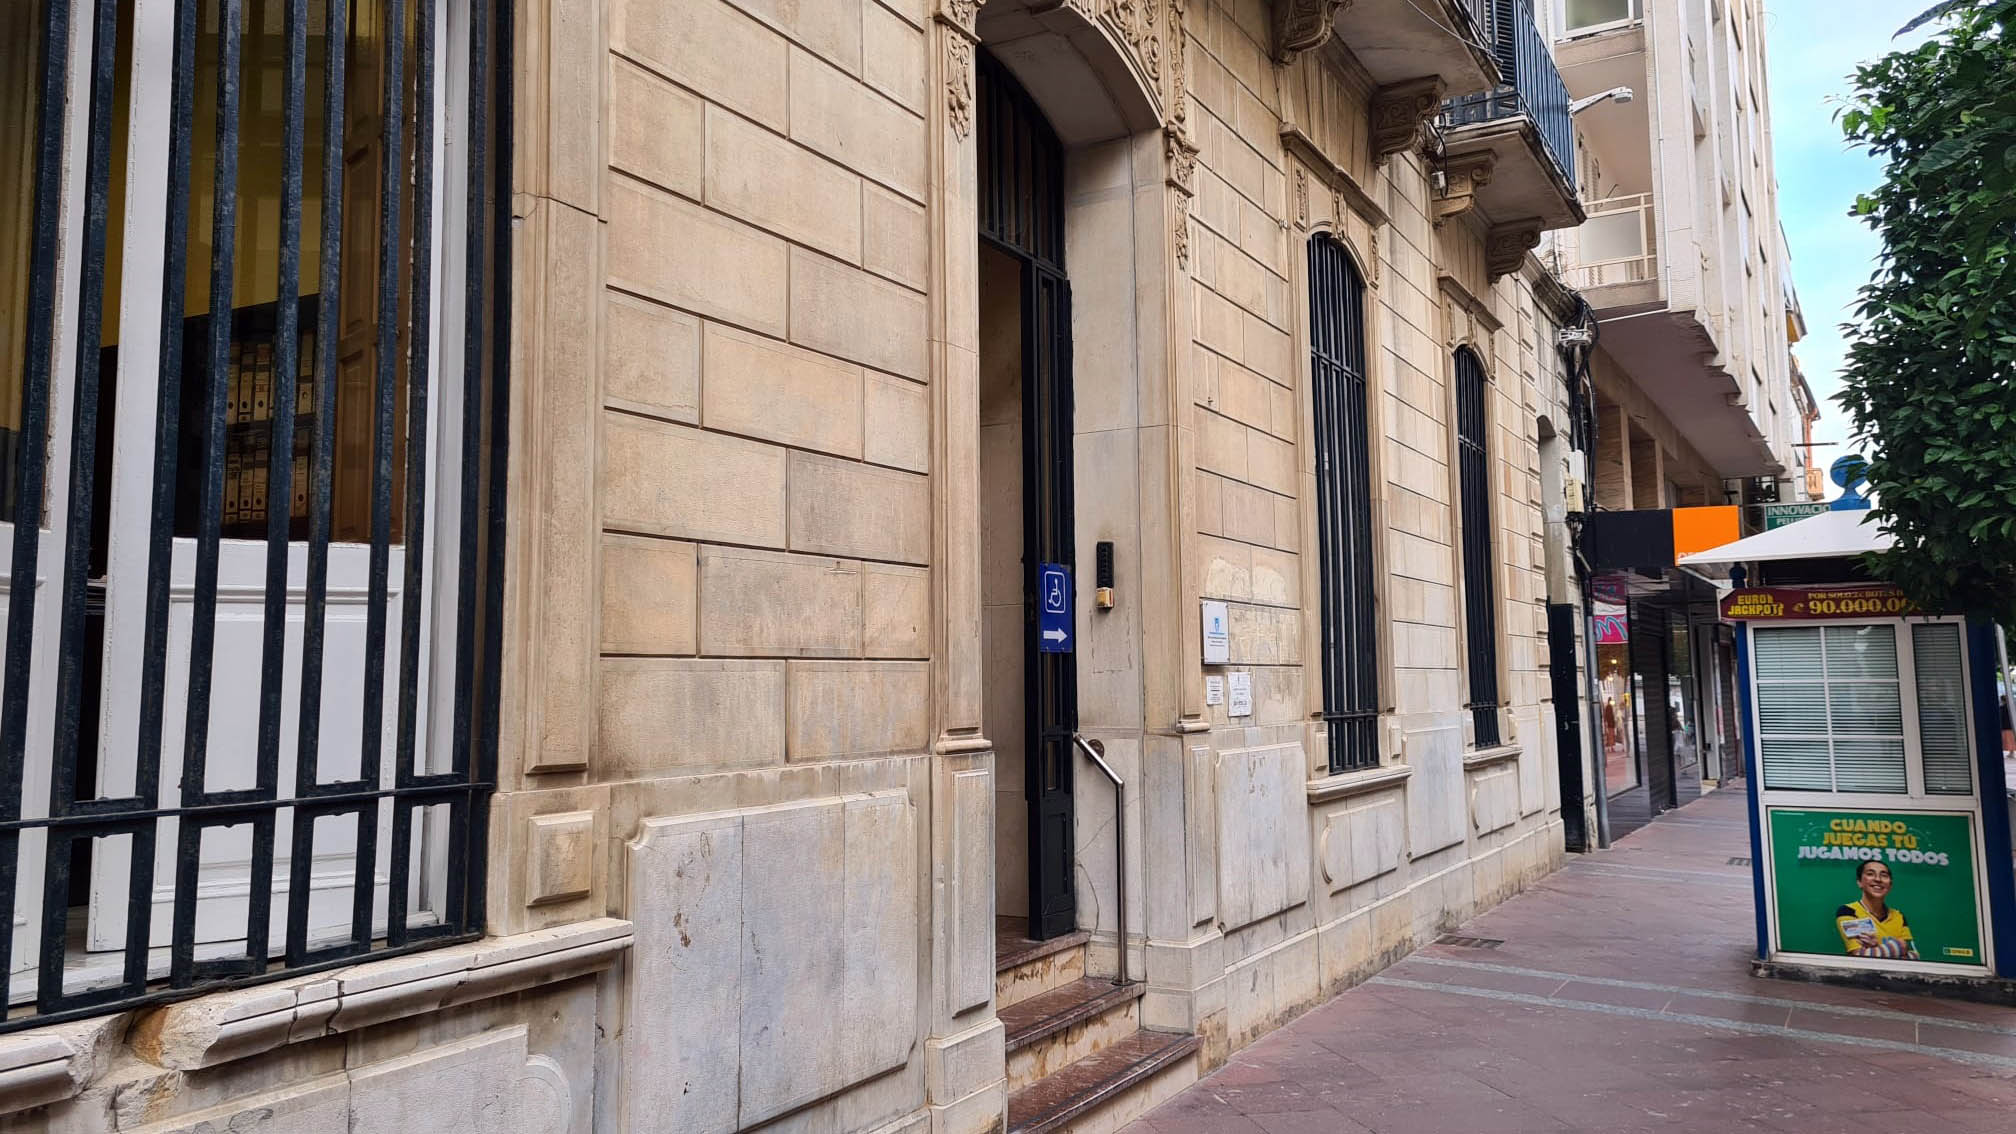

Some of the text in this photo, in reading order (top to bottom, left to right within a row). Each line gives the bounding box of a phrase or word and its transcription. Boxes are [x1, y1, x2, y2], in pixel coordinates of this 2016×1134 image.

[1830, 819, 1906, 833] CUANDO
[1823, 832, 1917, 848] JUEGAS TÚ
[1798, 846, 1949, 866] JUGAMOS TODOS
